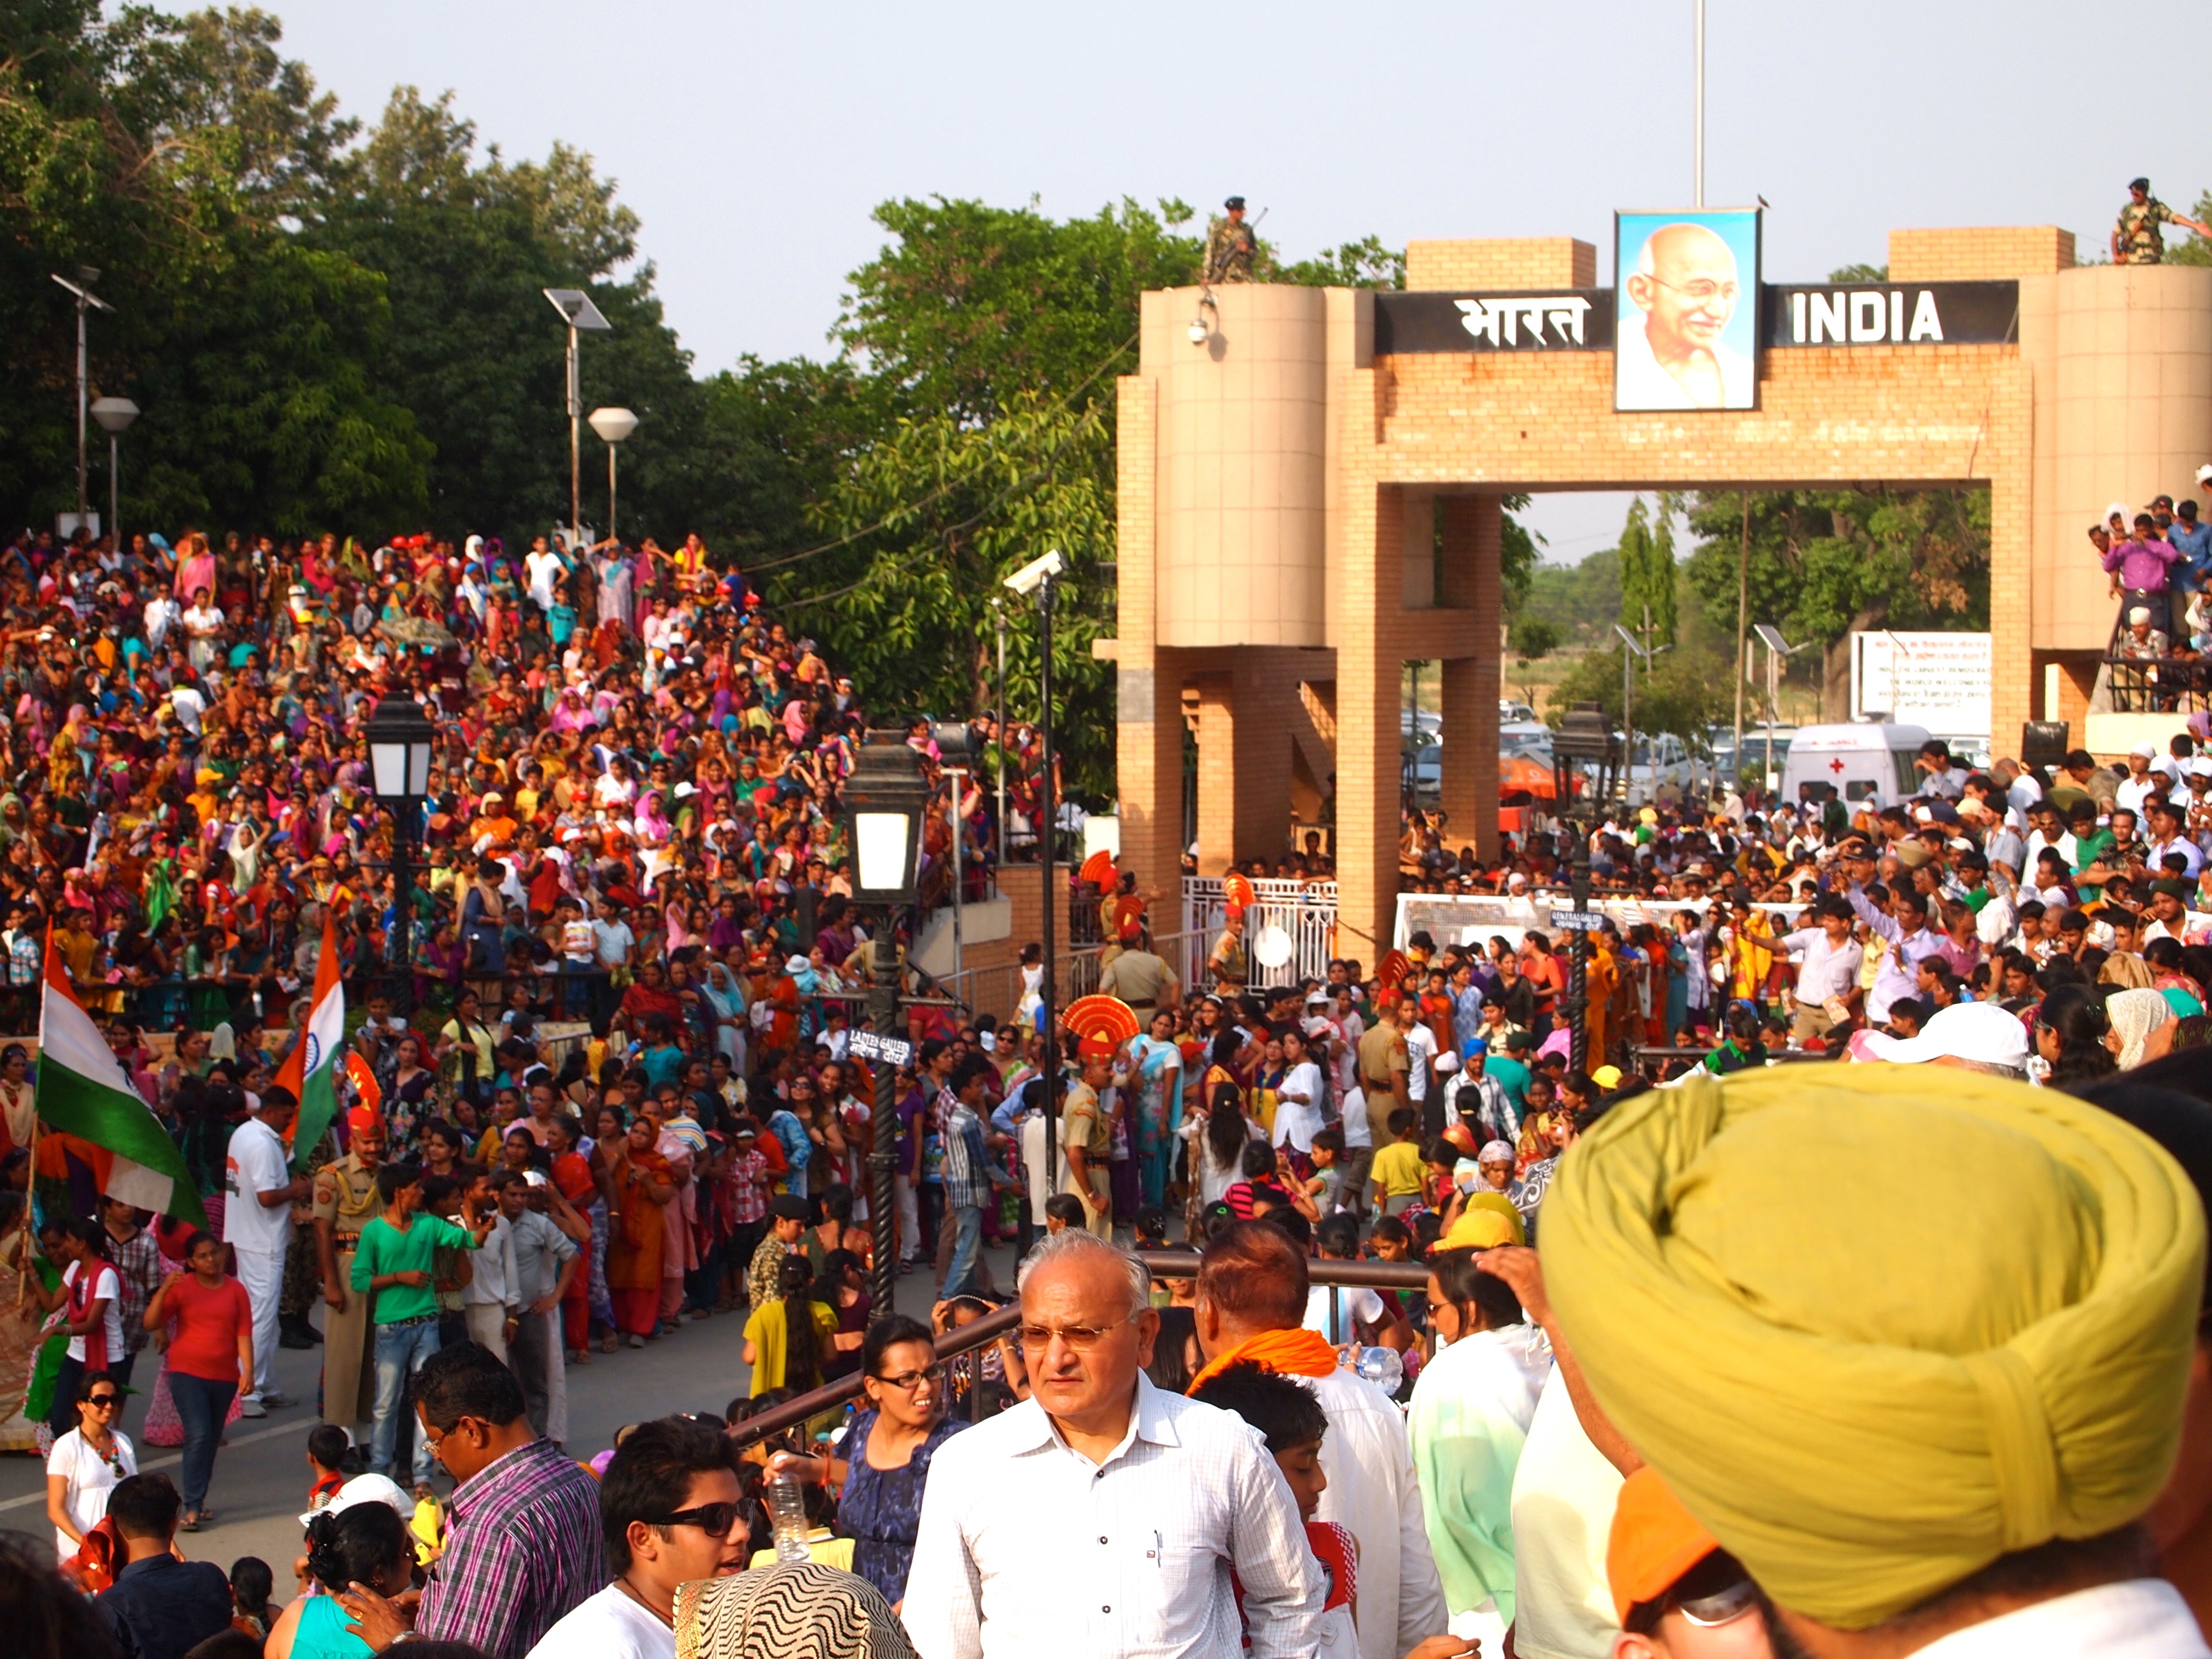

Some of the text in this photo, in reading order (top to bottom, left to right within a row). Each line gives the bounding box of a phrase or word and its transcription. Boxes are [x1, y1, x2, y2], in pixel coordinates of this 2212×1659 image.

[1454, 297, 1592, 347] भारत
[1793, 290, 1944, 343] INDIA
[849, 1029, 879, 1047] LADIES
